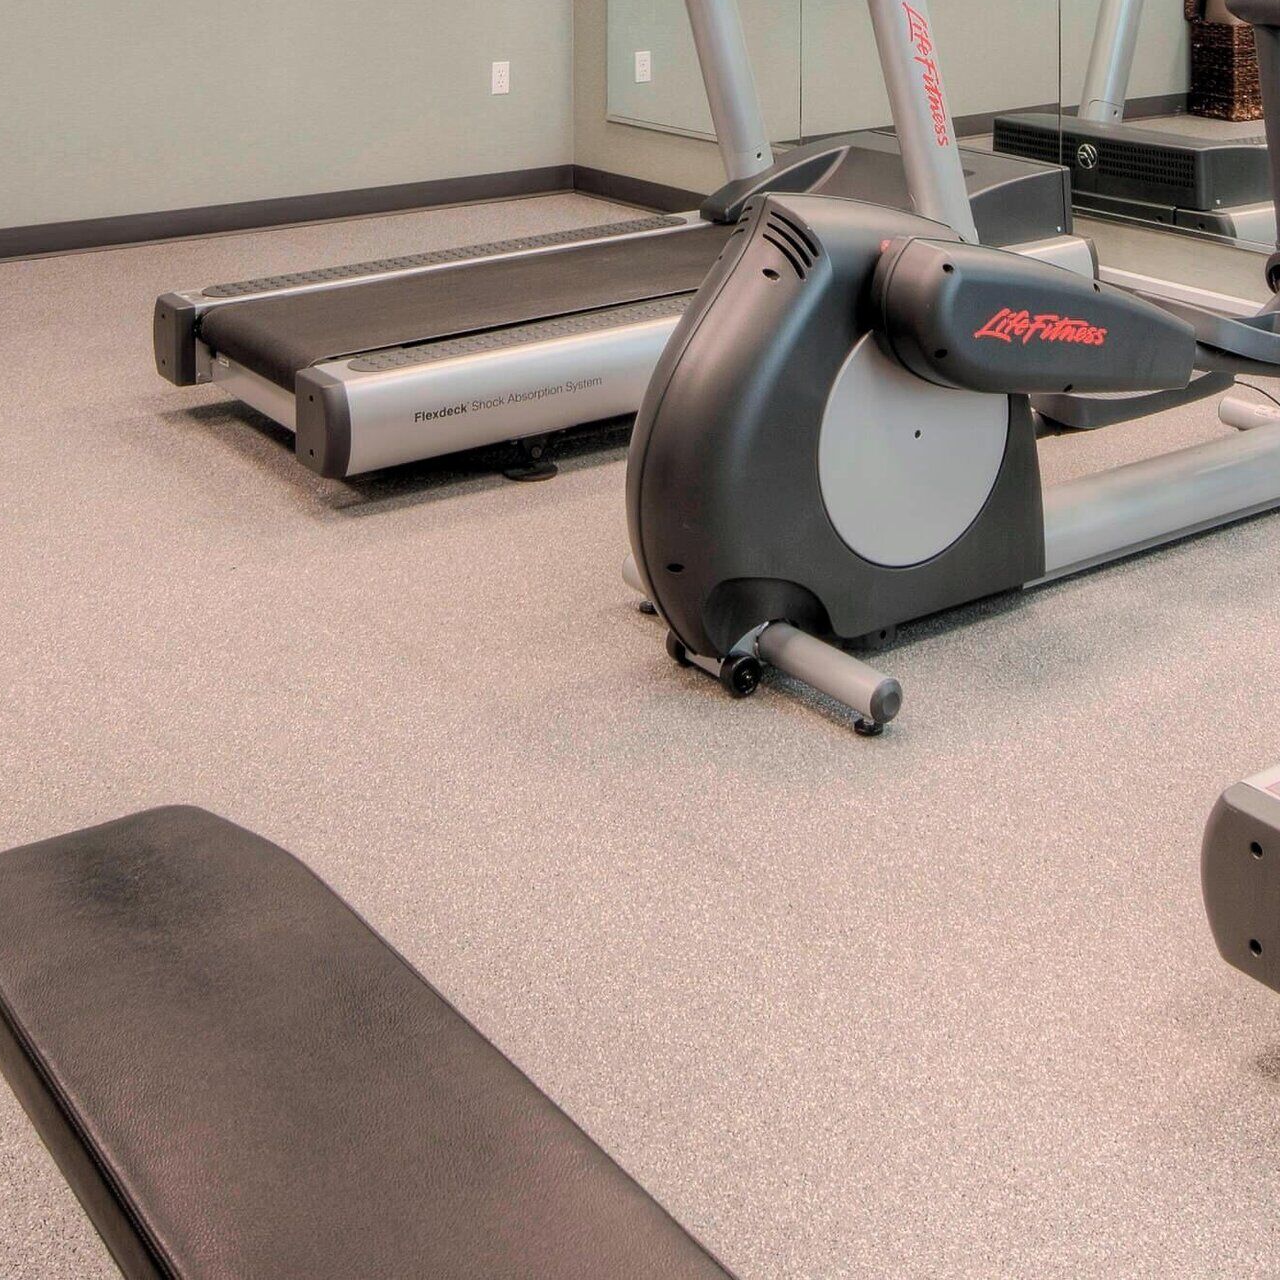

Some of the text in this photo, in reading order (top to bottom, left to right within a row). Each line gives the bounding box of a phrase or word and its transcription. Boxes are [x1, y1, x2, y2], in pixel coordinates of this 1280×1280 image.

[902, 1, 949, 147] Life Fitness
[973, 307, 1108, 346] Life Fitness
[414, 375, 603, 423] Flexdeck Shock Absorption System
